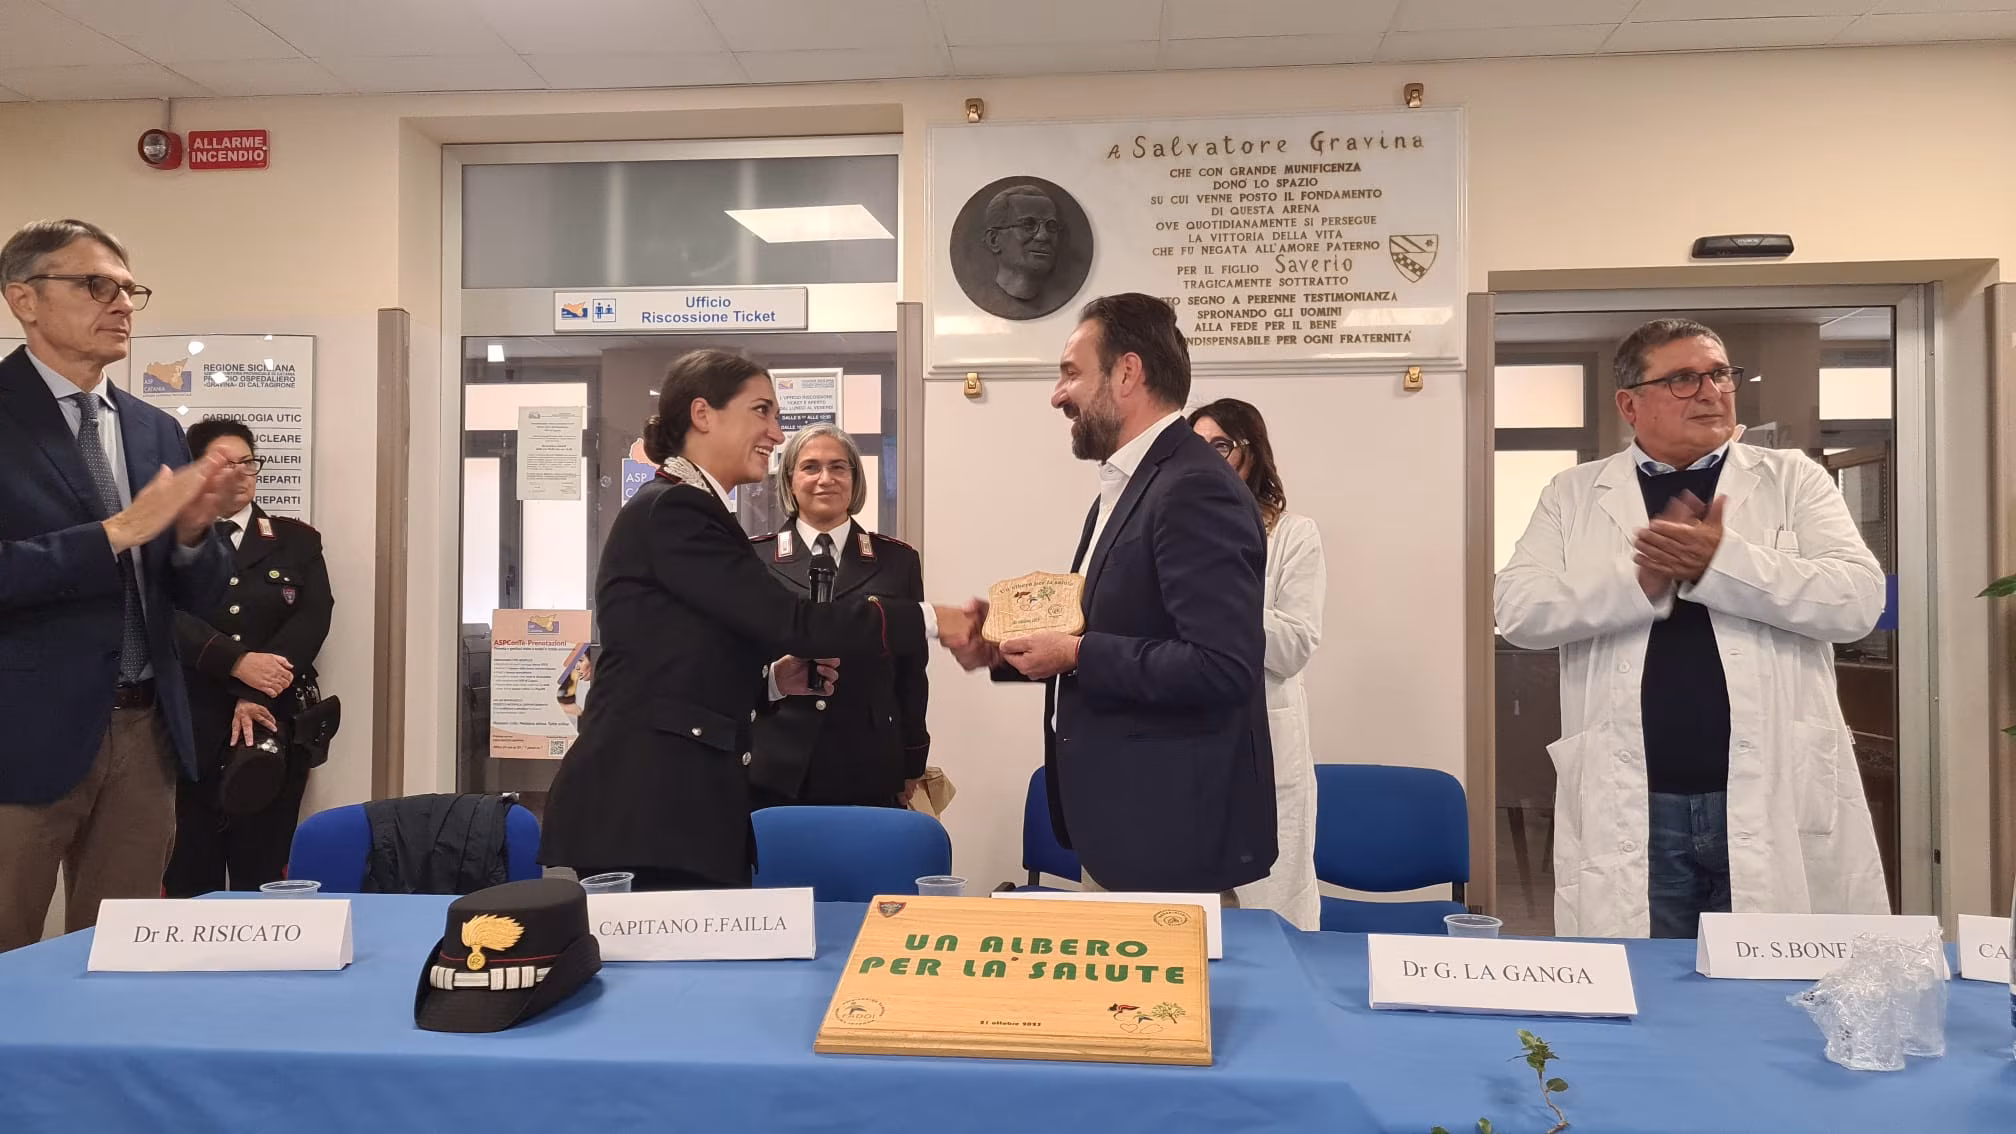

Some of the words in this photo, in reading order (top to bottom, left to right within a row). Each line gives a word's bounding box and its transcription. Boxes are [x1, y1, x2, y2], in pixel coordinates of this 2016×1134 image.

[194, 137, 263, 148] ALLARME
[1107, 144, 1121, 159] A
[1133, 135, 1287, 159] Salvatore
[1310, 130, 1424, 155] Gravina
[192, 150, 264, 162] INCENDIO
[1170, 168, 1192, 178] CHE
[1199, 168, 1223, 177] CON
[1230, 166, 1276, 175] GRANDE
[1284, 162, 1361, 174] MUNIFICENZA
[1255, 179, 1269, 188] LO
[1276, 178, 1318, 188] SPAZIO
[1151, 196, 1163, 205] SU
[1171, 195, 1188, 204] CUI
[1197, 194, 1232, 203] VENNE
[1239, 193, 1277, 202] POSTO
[1284, 192, 1294, 201] IL
[1301, 189, 1382, 200] FONDAMENTO
[1211, 207, 1223, 216] DI
[1230, 205, 1274, 215] QUESTA
[1283, 204, 1320, 214] ARENA
[1156, 222, 1179, 230] OVE
[1186, 218, 1297, 230] QUOTIDIANAMENTE
[1304, 218, 1313, 226] SI
[1321, 216, 1376, 226] PERSEGUE
[1189, 234, 1202, 243] LA
[1210, 232, 1264, 242] VITTORIA
[1272, 231, 1307, 240] DELLA
[1315, 230, 1343, 239] VITA
[1152, 247, 1174, 256] CHE
[1201, 245, 1247, 255] NEGATA
[1327, 241, 1380, 251] PATERNO
[1177, 266, 1197, 275] PER
[1205, 266, 1214, 274] IL
[1222, 265, 1259, 274] FIGLIO
[1275, 254, 1352, 274] Saverio
[1184, 278, 1272, 289] TRAGICAMENTE
[1279, 276, 1349, 287] SOTTRATTO
[685, 296, 731, 308] Ufficio
[1188, 296, 1225, 305] SEGNO
[1232, 296, 1240, 304] A
[1248, 294, 1296, 304] PERENNE
[1304, 291, 1397, 302] TESTIMONIANZA
[642, 311, 728, 323] Riscossione
[733, 310, 775, 322] Ticket
[1197, 309, 1267, 319] SPRONANDO
[1274, 308, 1293, 317] GLI
[1300, 307, 1342, 317] UOMINI
[1195, 323, 1222, 332] ALLA
[1231, 322, 1258, 331] FEDE
[1265, 321, 1285, 330] PER
[1292, 321, 1302, 330] IL
[1310, 320, 1336, 329] BENE
[1185, 336, 1270, 346] NDISPENSABILE
[1276, 335, 1297, 344] PER
[1304, 335, 1333, 344] OGNI
[247, 364, 295, 372] SICIANA
[202, 413, 274, 422] CARDIOLOGIA
[276, 414, 302, 422] UTIC
[253, 434, 302, 443] UCLEARE
[255, 455, 301, 464] DALIERI
[625, 473, 647, 483] ASP
[255, 496, 300, 504] REPARTI
[600, 918, 698, 936] CAPITANO
[704, 916, 787, 933] F.FAILLA
[134, 926, 160, 943] Dr
[166, 925, 184, 943] R.
[192, 924, 301, 943] RISICATO
[905, 934, 958, 951] UN
[979, 936, 1147, 957] ALBERO
[1736, 941, 1764, 958] Dr.
[1770, 942, 1855, 959] S.BONF
[1979, 943, 2010, 960] CA
[859, 956, 941, 976] PER
[963, 960, 1006, 978] LA
[1028, 962, 1184, 984] SALUTE
[1403, 960, 1427, 978] Dr
[1434, 962, 1457, 979] G.
[1464, 964, 1496, 981] LA
[1503, 965, 1594, 985] GANGA
